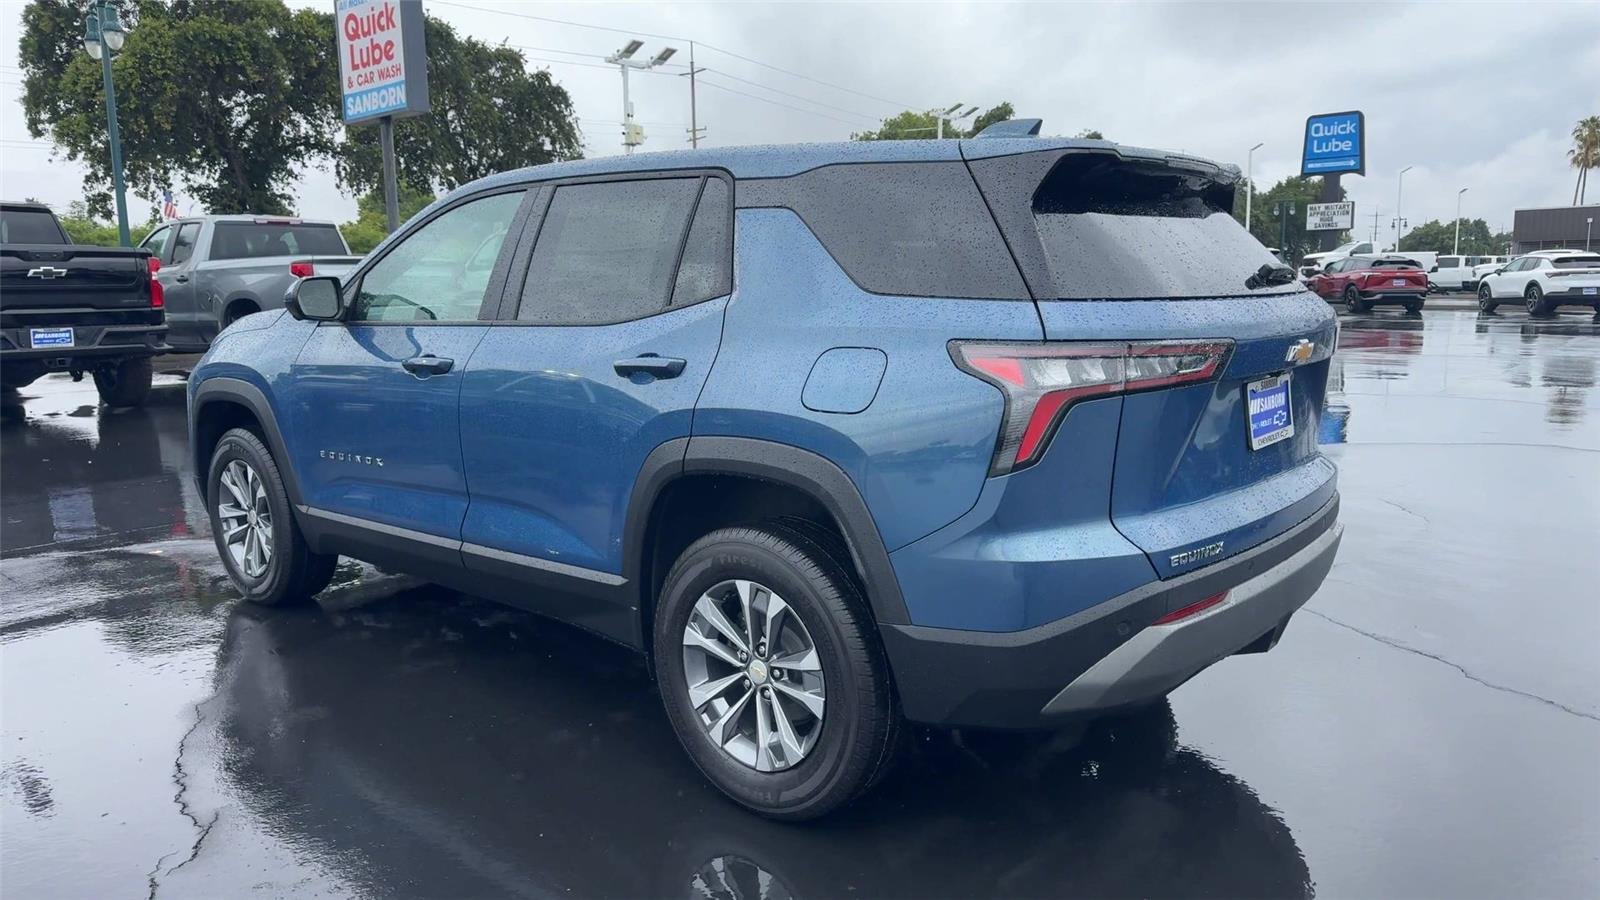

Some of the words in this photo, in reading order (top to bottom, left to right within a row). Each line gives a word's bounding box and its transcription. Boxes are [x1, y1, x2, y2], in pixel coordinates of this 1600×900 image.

[345, 2, 396, 41] Quick
[350, 38, 395, 71] Lube
[347, 76, 354, 89] &
[357, 71, 375, 87] CAR
[377, 63, 402, 81] WASH
[346, 84, 407, 117] SANBORN
[1311, 120, 1357, 137] Quick
[1313, 138, 1352, 153] Lube
[1260, 391, 1286, 412] SANBORN
[319, 450, 385, 466] EQUINOX
[1170, 541, 1225, 567] EQUINOX
